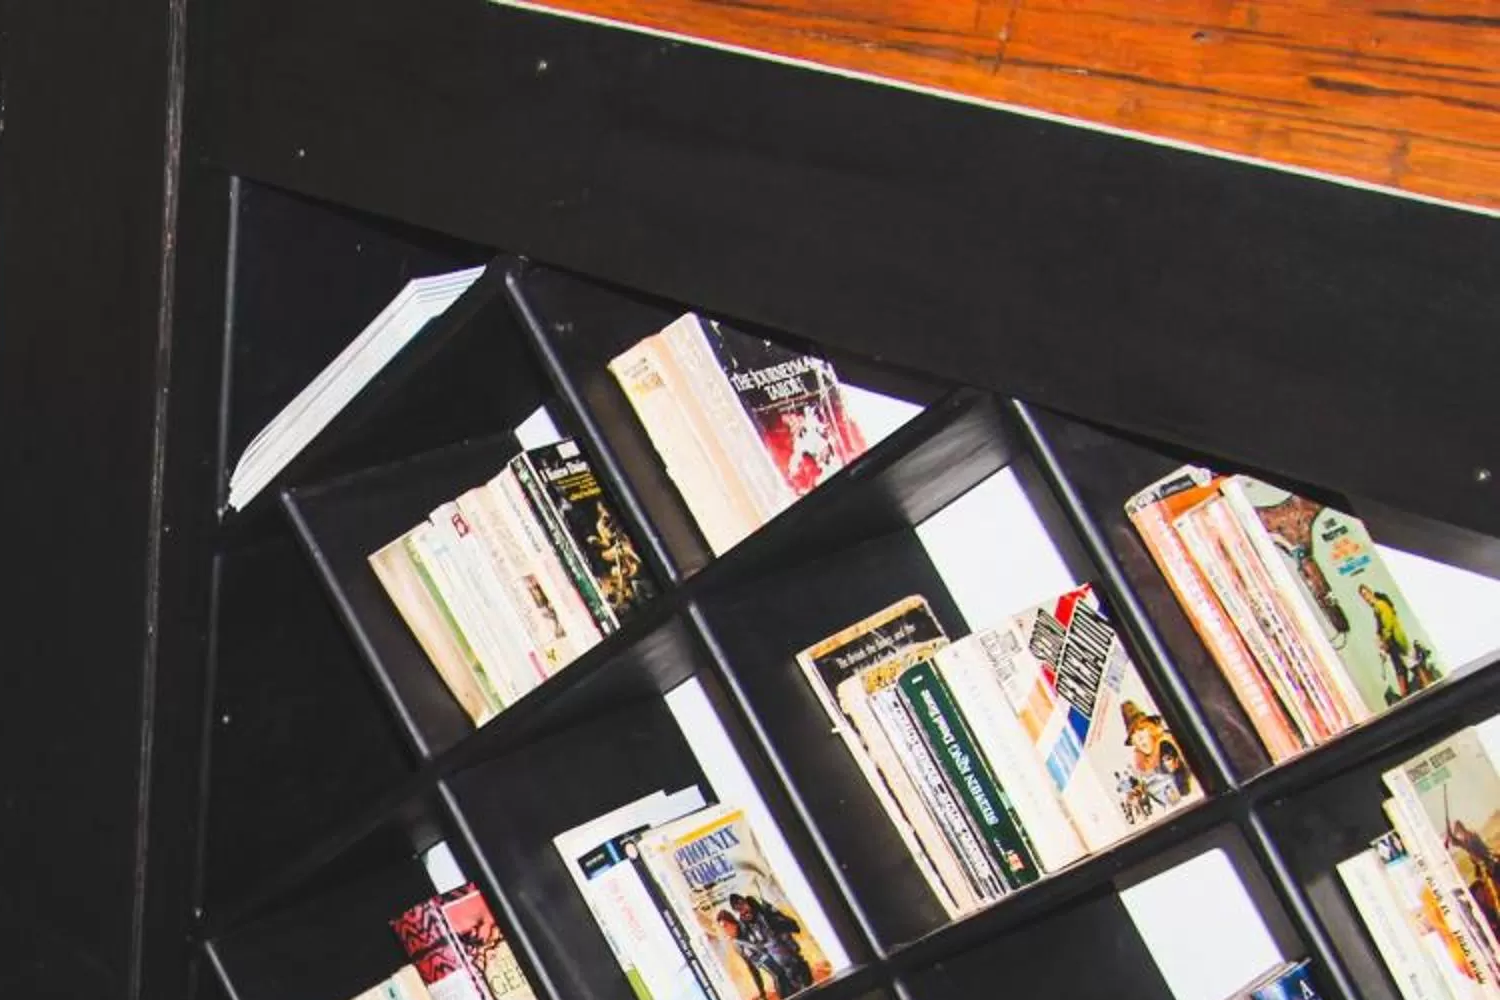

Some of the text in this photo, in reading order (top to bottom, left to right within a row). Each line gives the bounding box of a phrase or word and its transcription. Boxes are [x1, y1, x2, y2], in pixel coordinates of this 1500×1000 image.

[946, 741, 974, 775] KING
[962, 771, 999, 827] STEPHEN
[672, 824, 740, 867] PHOENIX
[684, 854, 734, 890] FORCE
